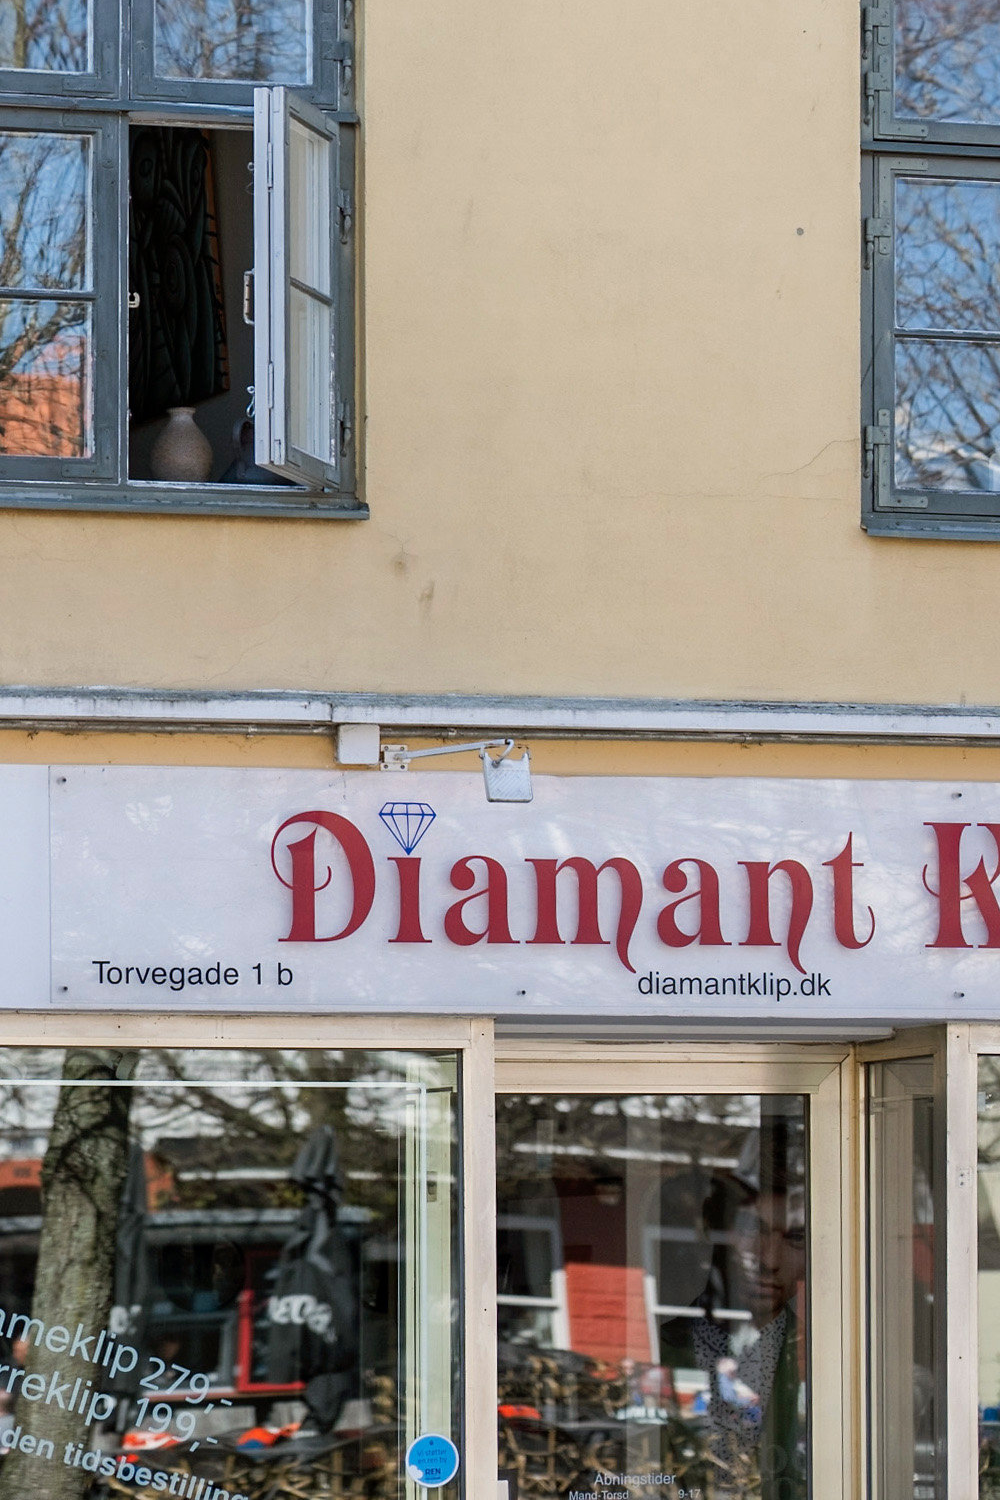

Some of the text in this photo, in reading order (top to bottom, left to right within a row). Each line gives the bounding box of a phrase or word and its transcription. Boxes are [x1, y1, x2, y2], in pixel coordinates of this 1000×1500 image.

[270, 809, 876, 975] Diamant
[92, 960, 294, 991] Torvegade 1 b
[637, 971, 831, 1002] diamantklip.dk
[139, 1356, 233, 1414] 279,-
[62, 1441, 250, 1500] tidsbestillin
